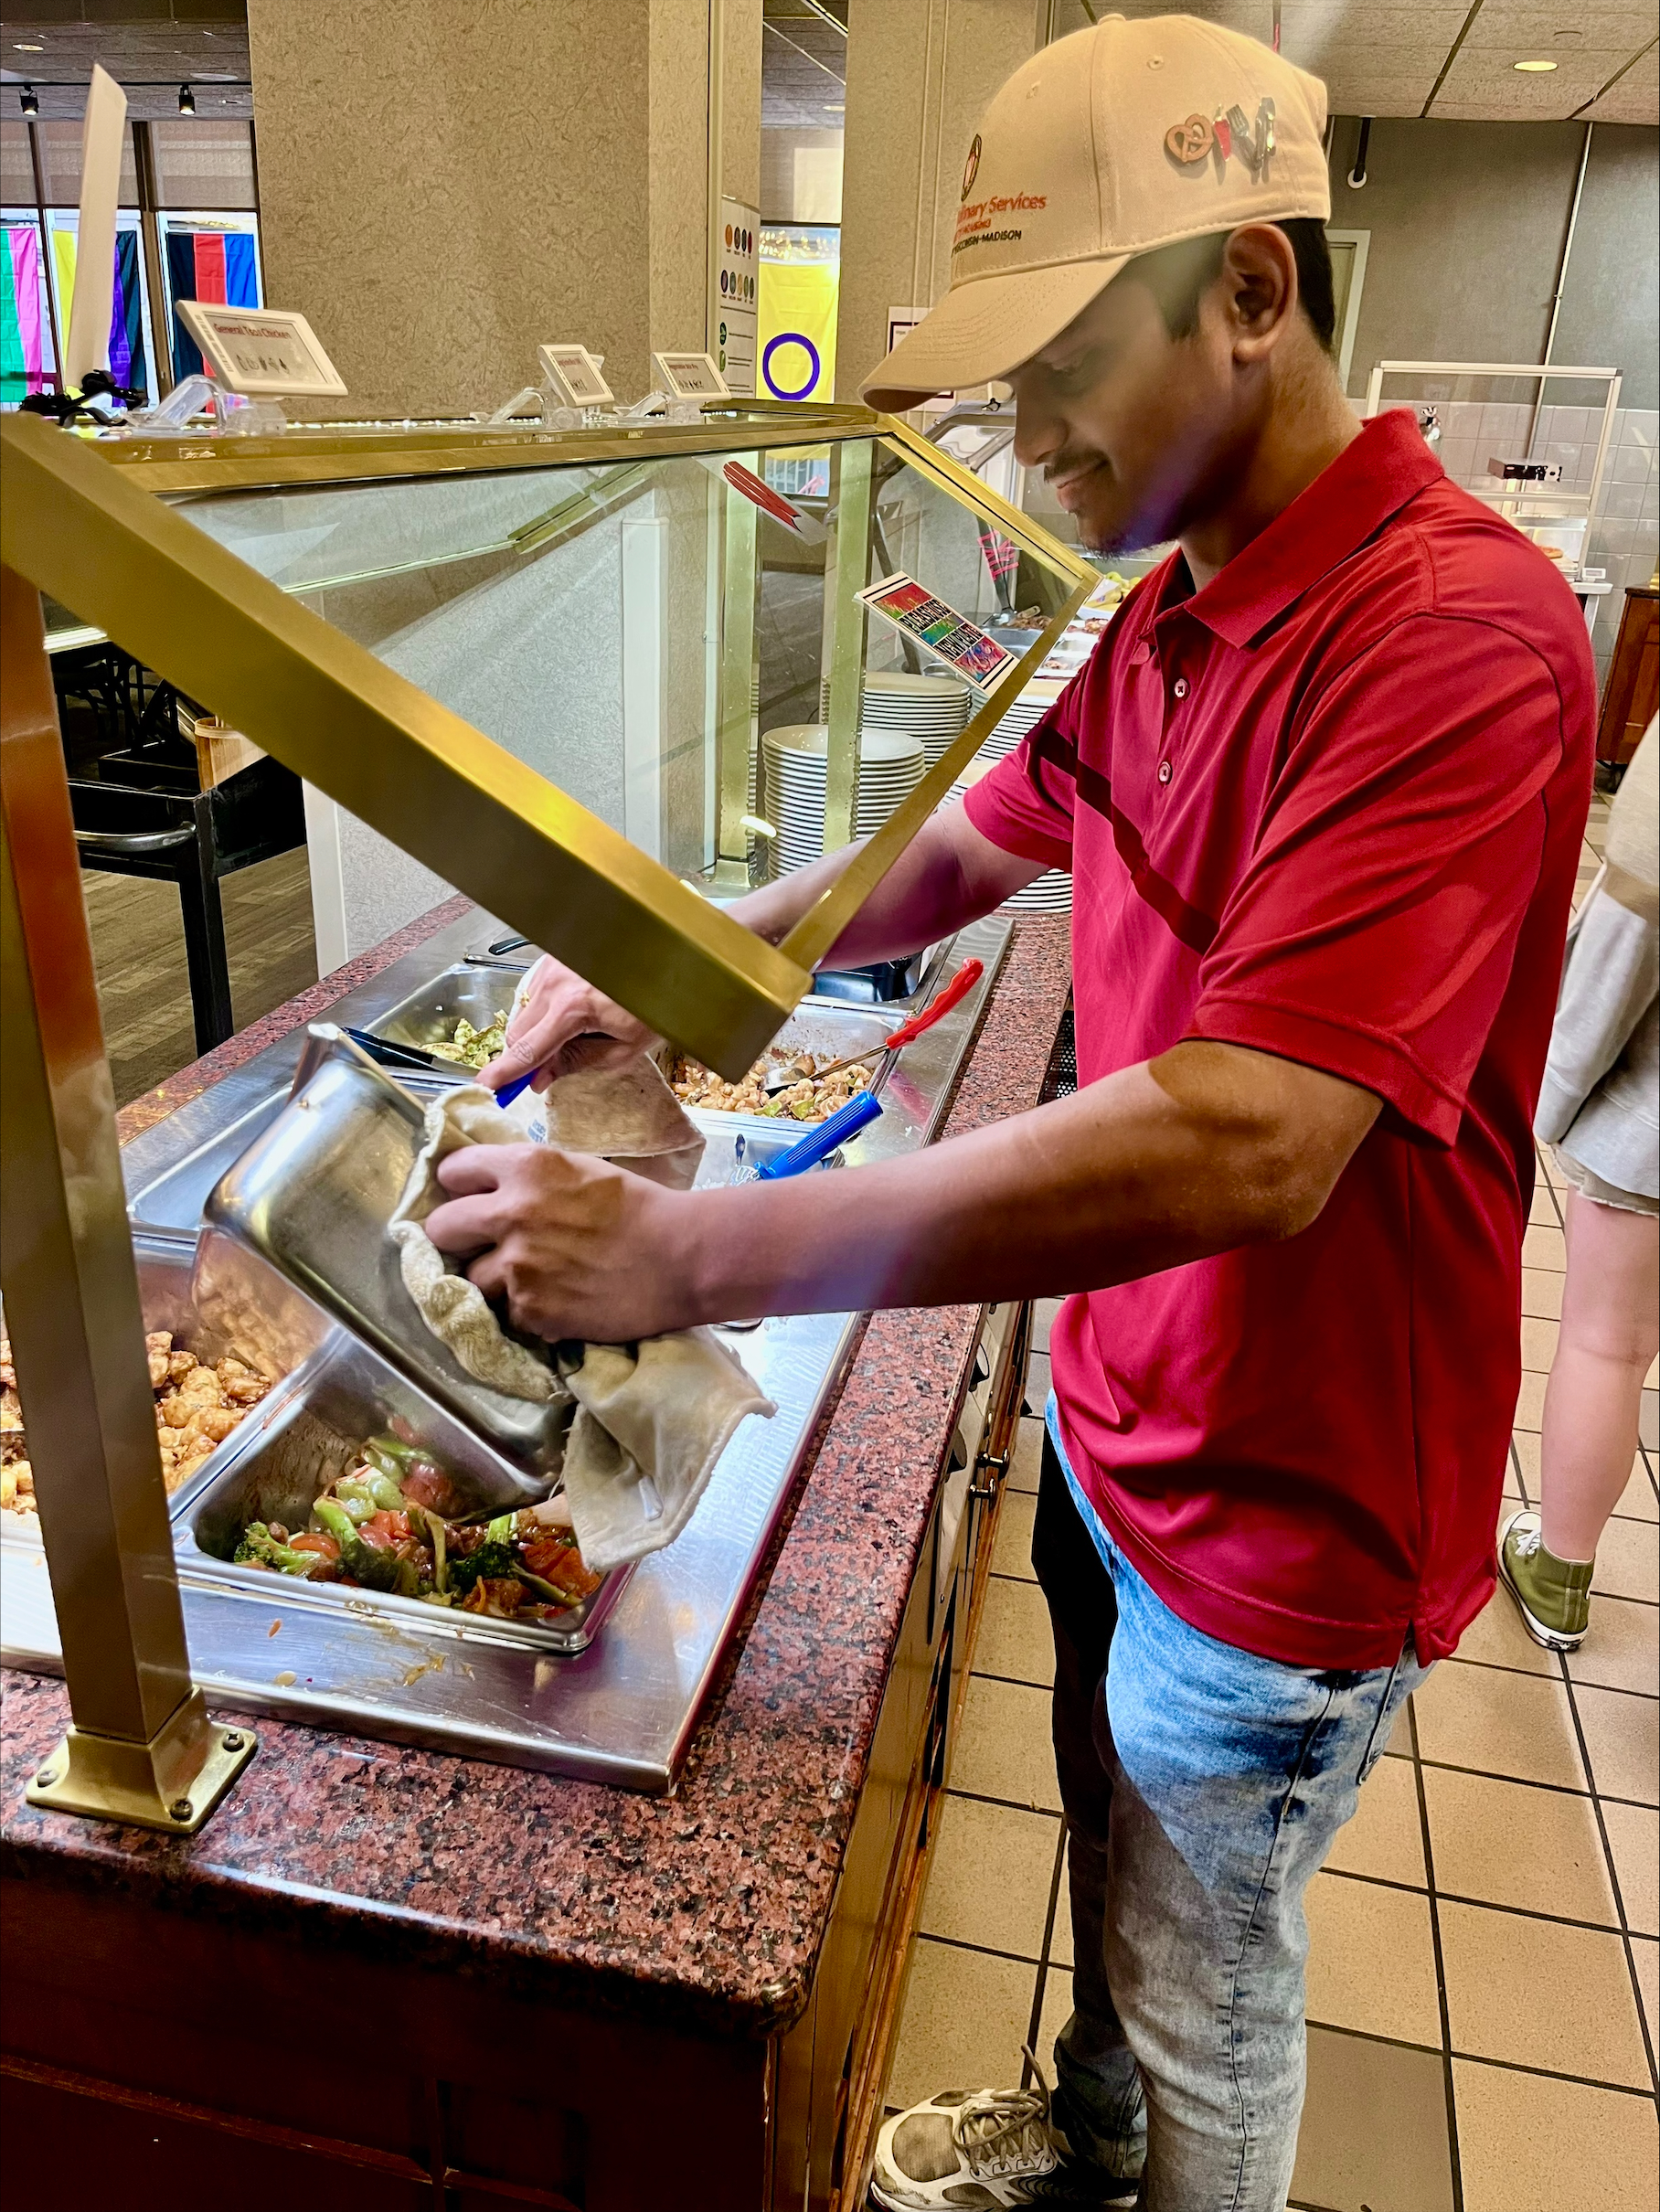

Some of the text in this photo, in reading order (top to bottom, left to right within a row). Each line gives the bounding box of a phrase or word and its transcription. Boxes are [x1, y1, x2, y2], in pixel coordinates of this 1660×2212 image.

[988, 191, 1048, 214] Services
[213, 323, 245, 335] General
[261, 328, 293, 339] Chicken
[899, 599, 952, 634] PLEASE USE
[933, 621, 984, 662] NEW PLATE
